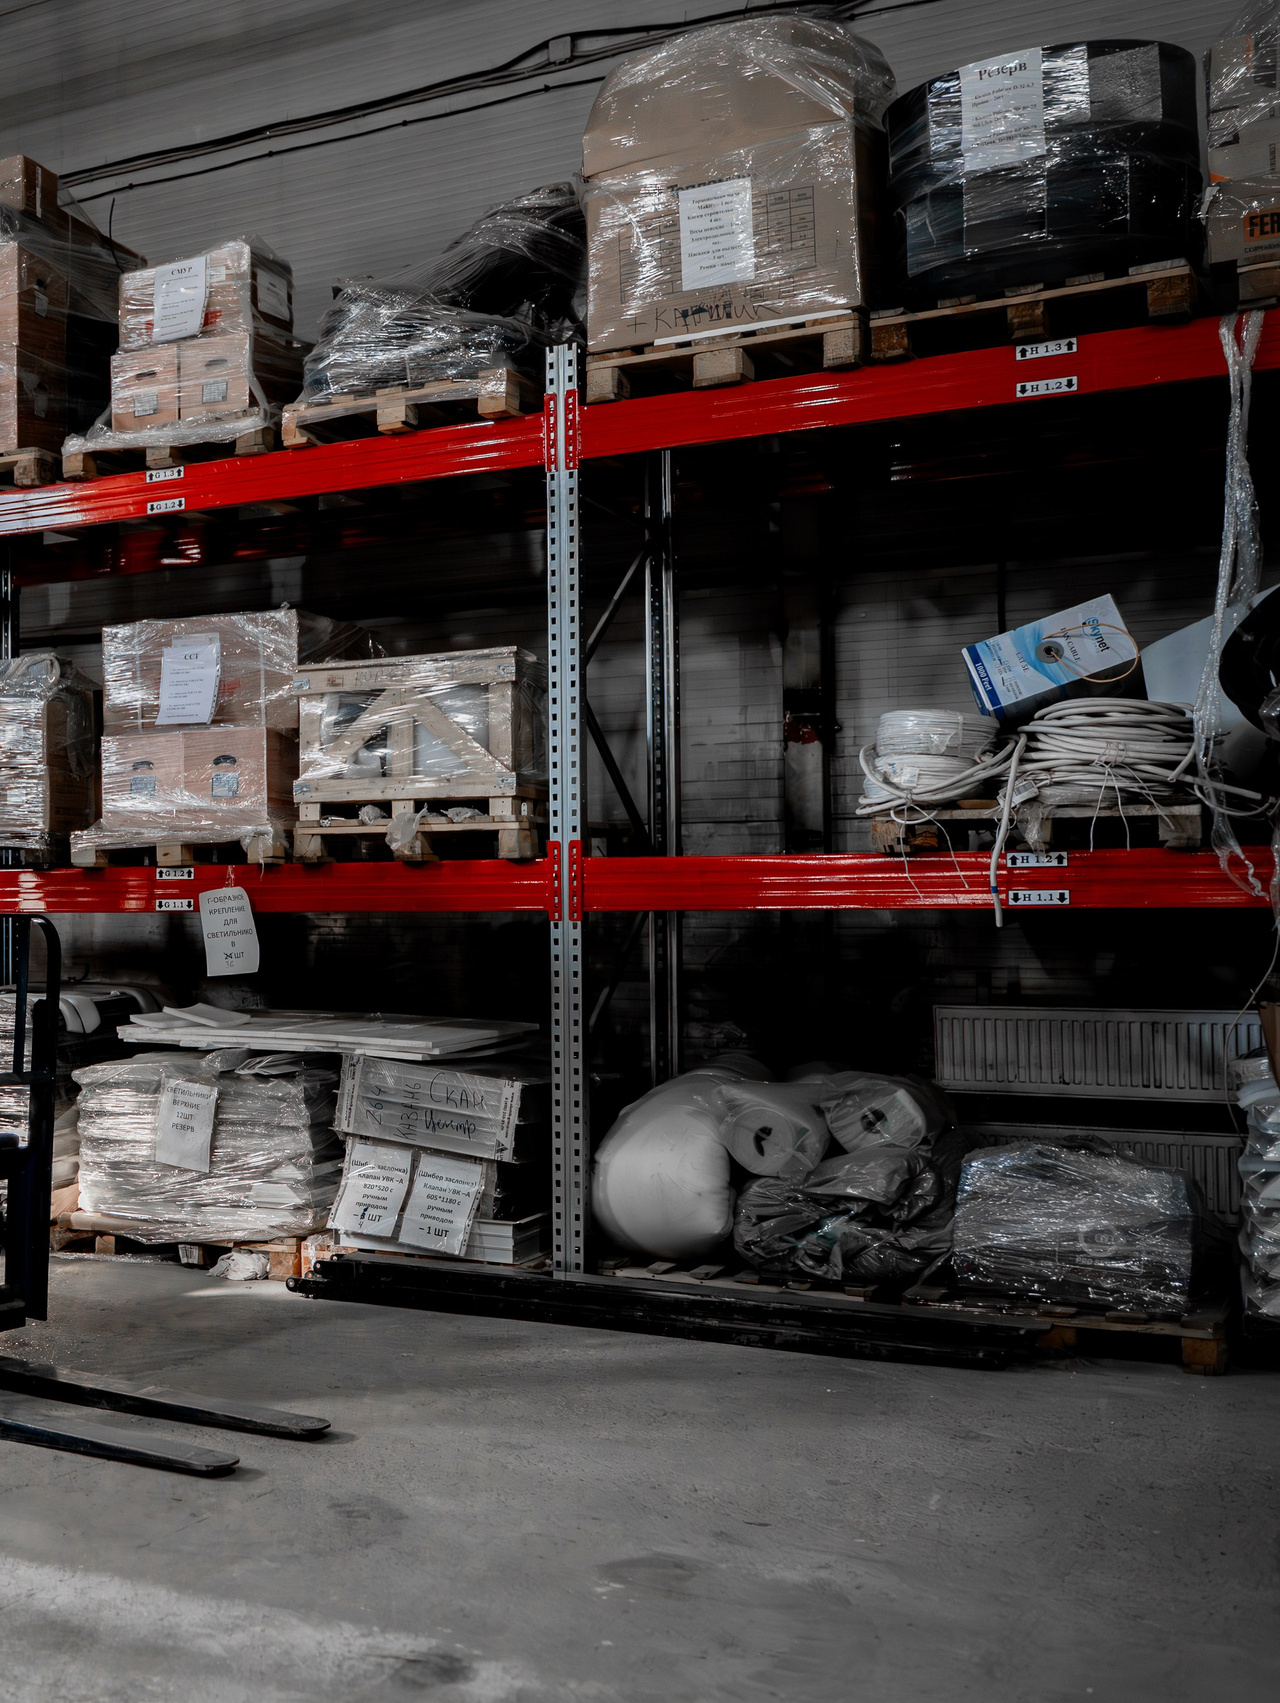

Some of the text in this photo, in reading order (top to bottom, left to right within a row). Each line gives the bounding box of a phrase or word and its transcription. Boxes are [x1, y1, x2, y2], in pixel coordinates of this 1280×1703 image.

[979, 62, 1027, 81] Резерв
[1030, 343, 1062, 355] H 1.3
[1045, 382, 1062, 391] 1.2
[1088, 616, 1111, 653] Skynet
[1067, 640, 1081, 663] CABLE
[980, 676, 993, 691] Feet
[207, 894, 245, 904] Г-ОБРАЗНОЕ
[208, 905, 246, 915] КРЕПЛЕНИЕ
[223, 918, 238, 927] ДЛЯ
[206, 928, 253, 940] СВЕТИЛЬНИКО
[225, 960, 234, 968] 36
[166, 1086, 212, 1099] СВЕТИЛЬНИКИ
[172, 1099, 200, 1110] ВЕРХНИЕ
[176, 1111, 194, 1121] 12ШТ
[171, 1122, 195, 1132] РЕЗЕРВ
[424, 1109, 477, 1140] Центр
[377, 1163, 409, 1175] заслонка)
[357, 1173, 381, 1182] Клапан
[381, 1176, 394, 1184] УВК
[418, 1169, 444, 1182] (Шибер
[423, 1183, 447, 1193] Клапан
[362, 1193, 388, 1202] ручным
[355, 1202, 388, 1212] приводом
[426, 1204, 453, 1214] ручным
[367, 1214, 383, 1223] ШТ
[420, 1213, 454, 1224] приводом
[426, 1226, 431, 1234] 1
[434, 1227, 449, 1238] ШТ
